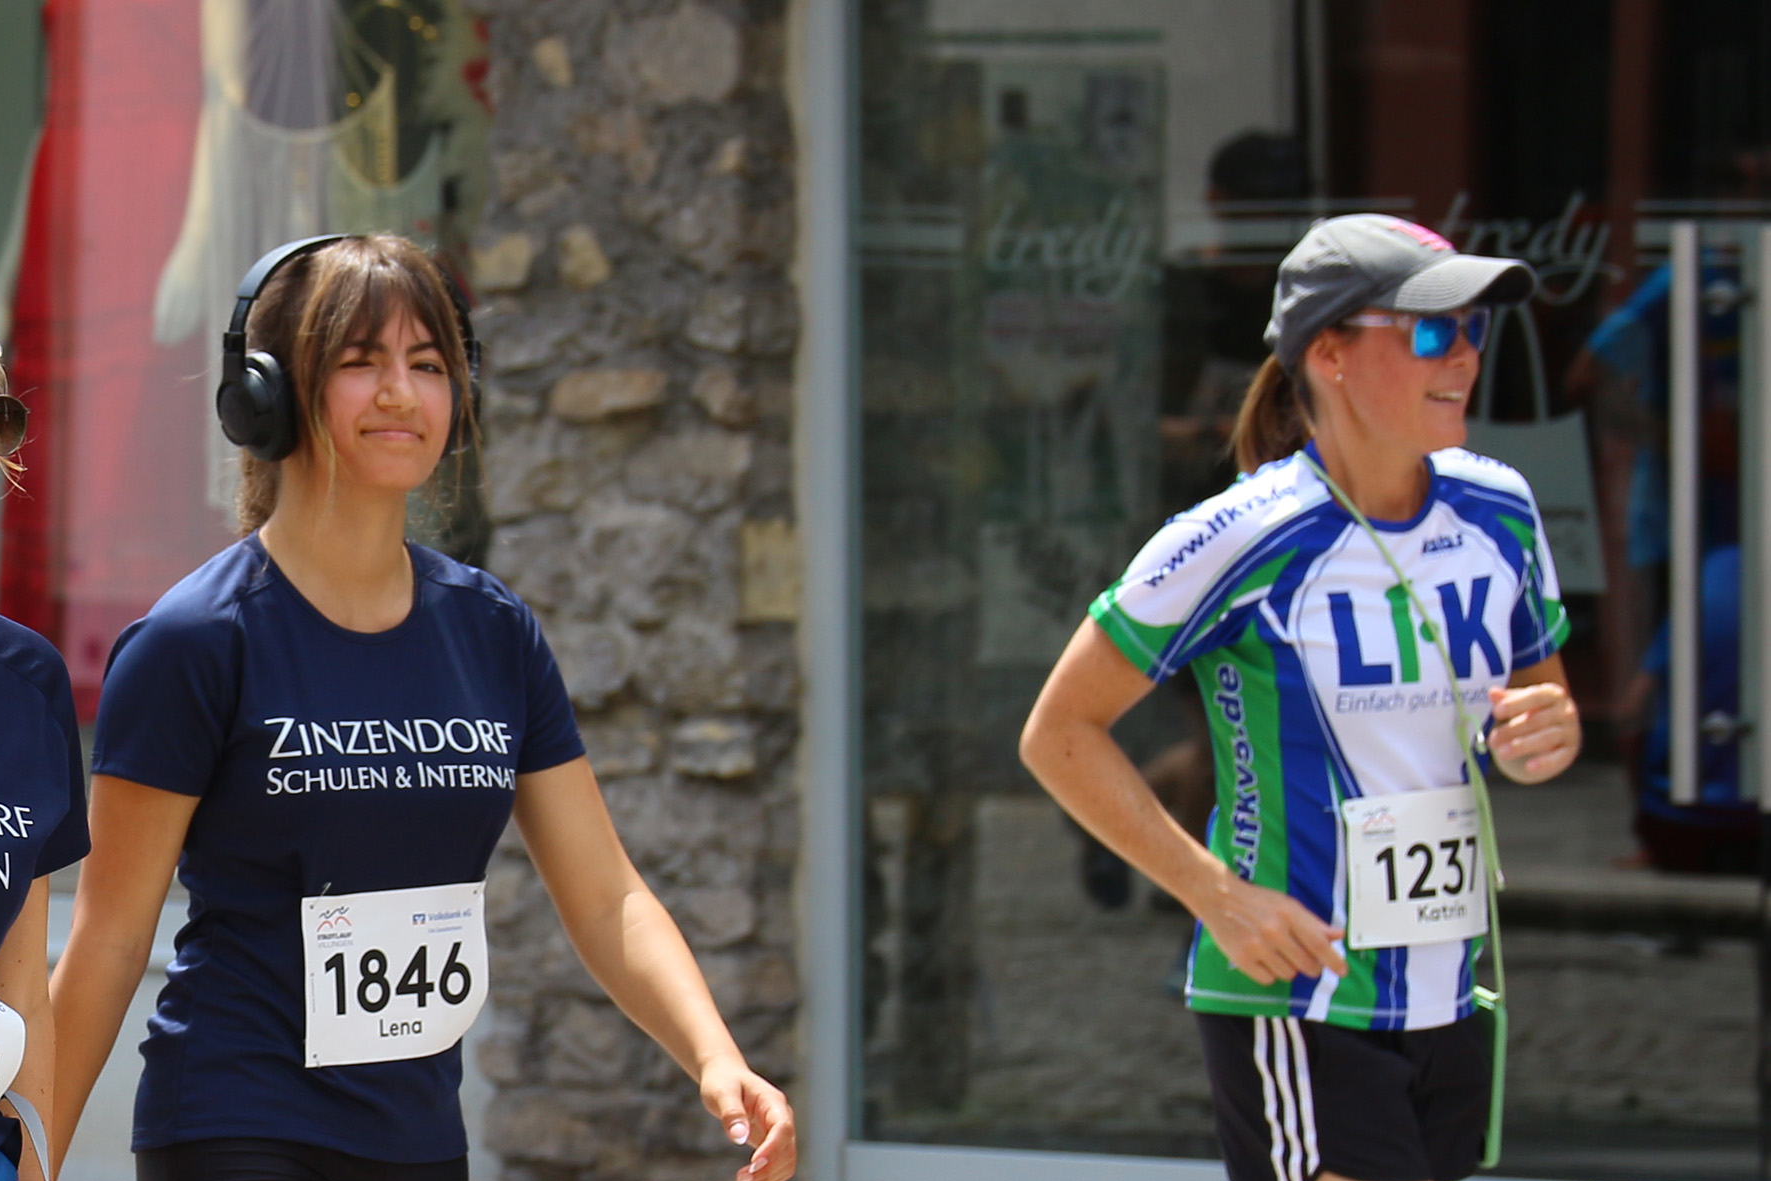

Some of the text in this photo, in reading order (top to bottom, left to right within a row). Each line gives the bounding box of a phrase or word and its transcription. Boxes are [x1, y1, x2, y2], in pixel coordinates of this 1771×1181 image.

[984, 198, 1162, 300] tredy
[1435, 192, 1622, 305] tredy
[1335, 691, 1404, 713] Einfach
[1407, 688, 1437, 713] gut
[264, 717, 512, 759] ZINZENDORF
[266, 767, 388, 795] SCHULEN
[395, 765, 412, 789] &
[1376, 836, 1476, 901] 1237
[1417, 904, 1466, 922] Katrin
[317, 932, 352, 941] STADTLAUF
[324, 941, 471, 1016] 1846
[379, 1019, 423, 1038] Lena
